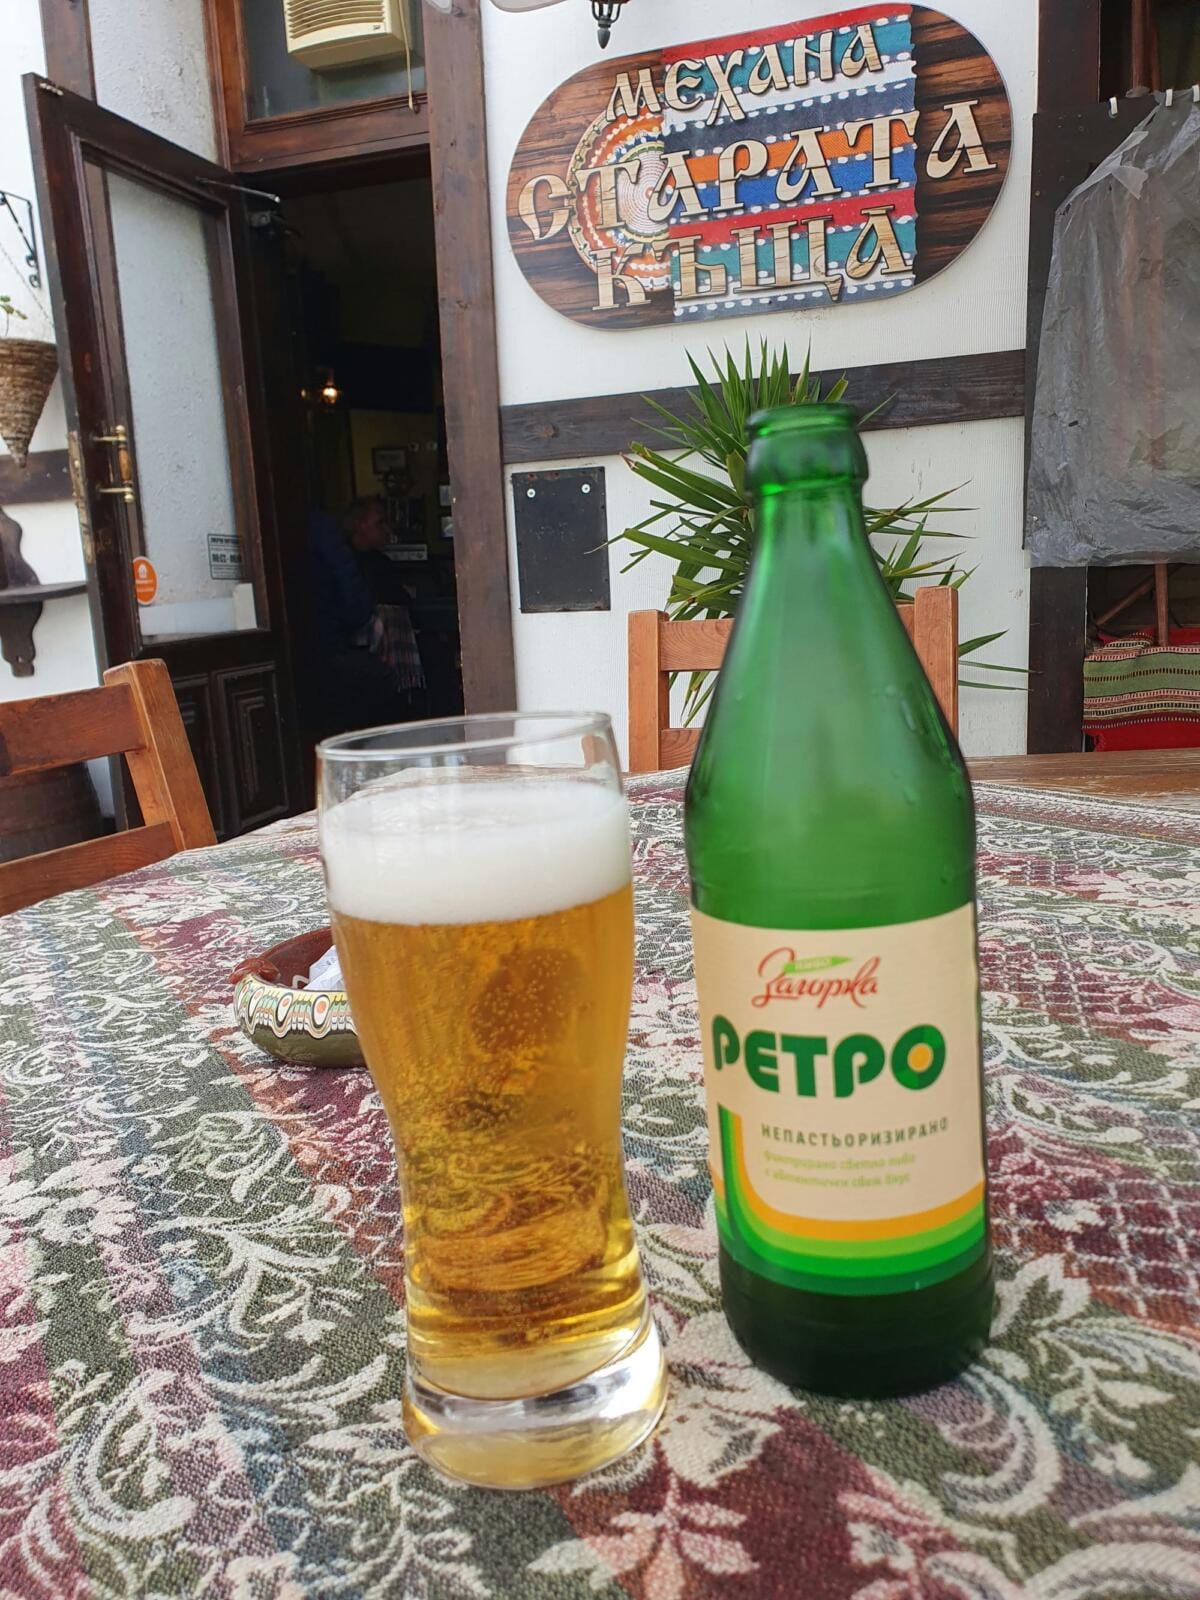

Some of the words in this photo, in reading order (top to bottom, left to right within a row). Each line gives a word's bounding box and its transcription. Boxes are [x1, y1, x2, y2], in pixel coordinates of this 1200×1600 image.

[605, 22, 885, 126] МЕХАНА
[517, 99, 999, 242] СТАРАТА
[592, 204, 915, 311] КЪЩА
[751, 946, 882, 1009] Загорка
[711, 1013, 946, 1099] РЕТРО
[760, 1116, 949, 1148] НЕПАСТЬОРИЗИРАНО
